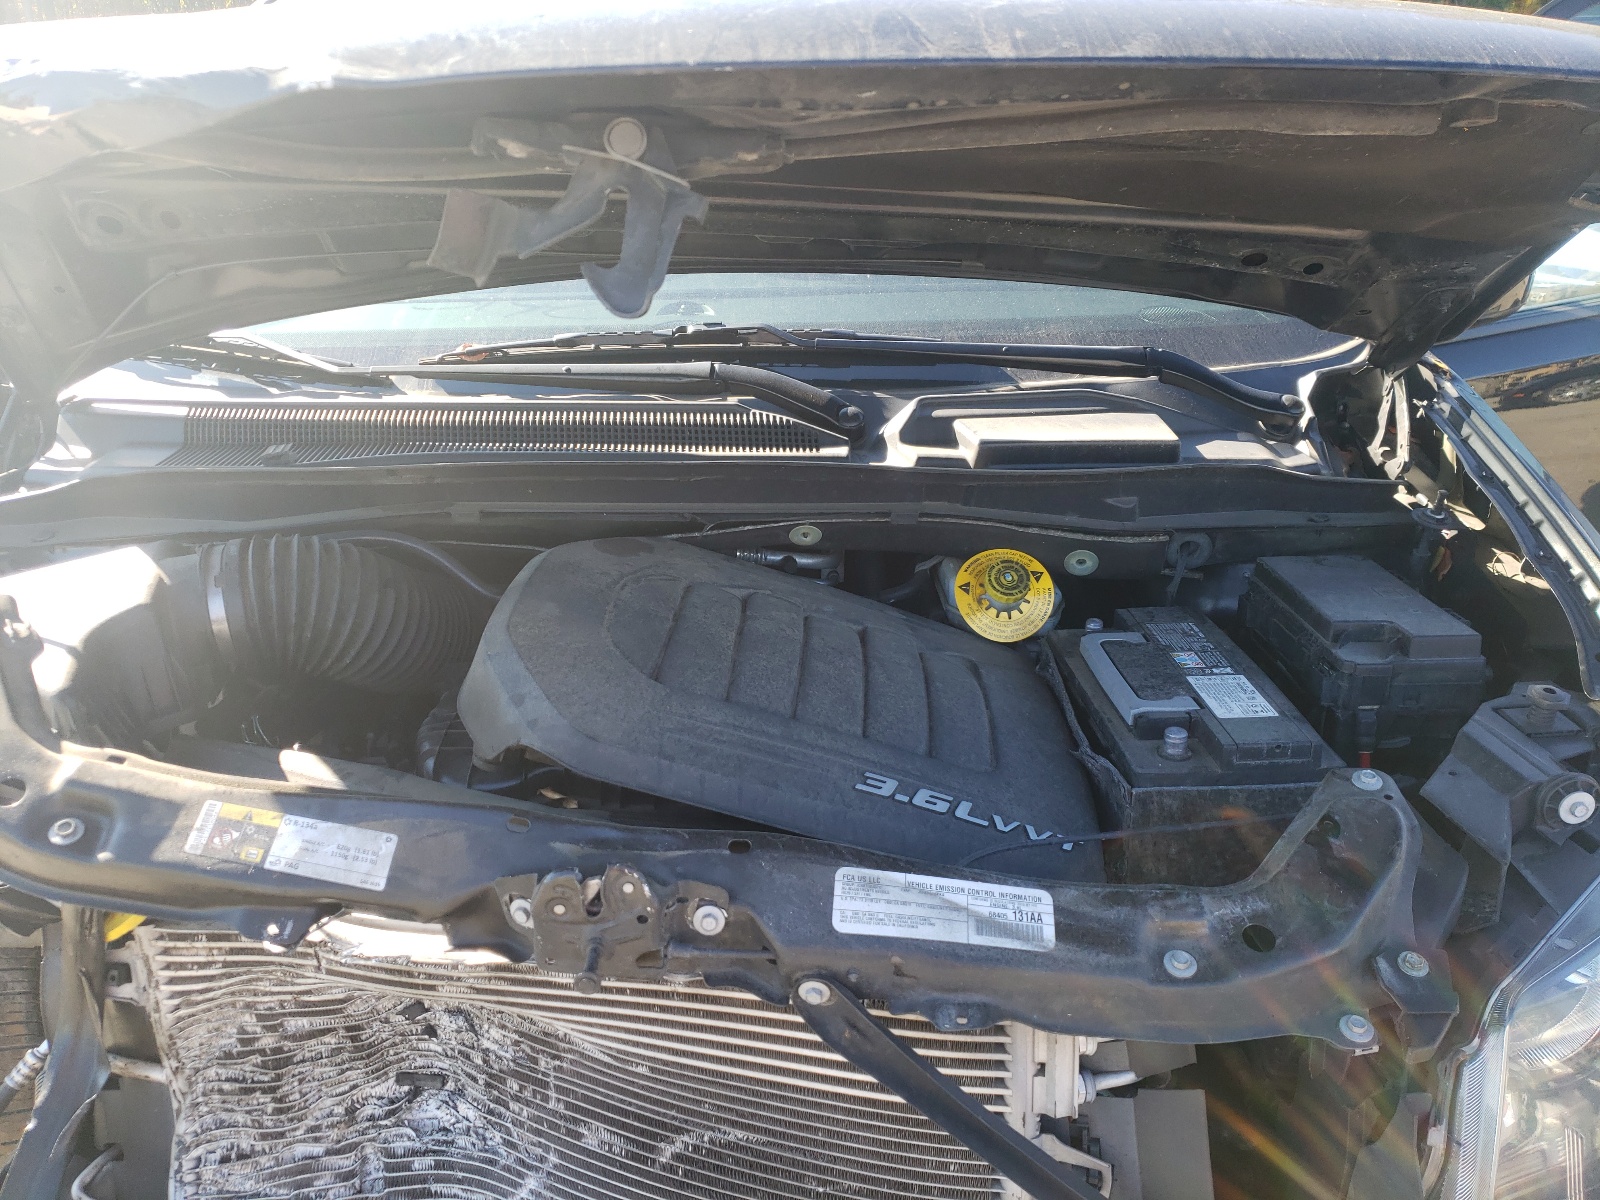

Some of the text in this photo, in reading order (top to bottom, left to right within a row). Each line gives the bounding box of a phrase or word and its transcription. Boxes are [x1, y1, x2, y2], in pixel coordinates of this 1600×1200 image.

[842, 874, 855, 882] FCA
[857, 875, 867, 883] US
[907, 880, 933, 890] VEHICLE
[935, 884, 966, 894] EMISSION
[967, 888, 996, 898] CONTROL
[998, 892, 1042, 903] INFORMATION
[1012, 910, 1044, 924] 131AA
